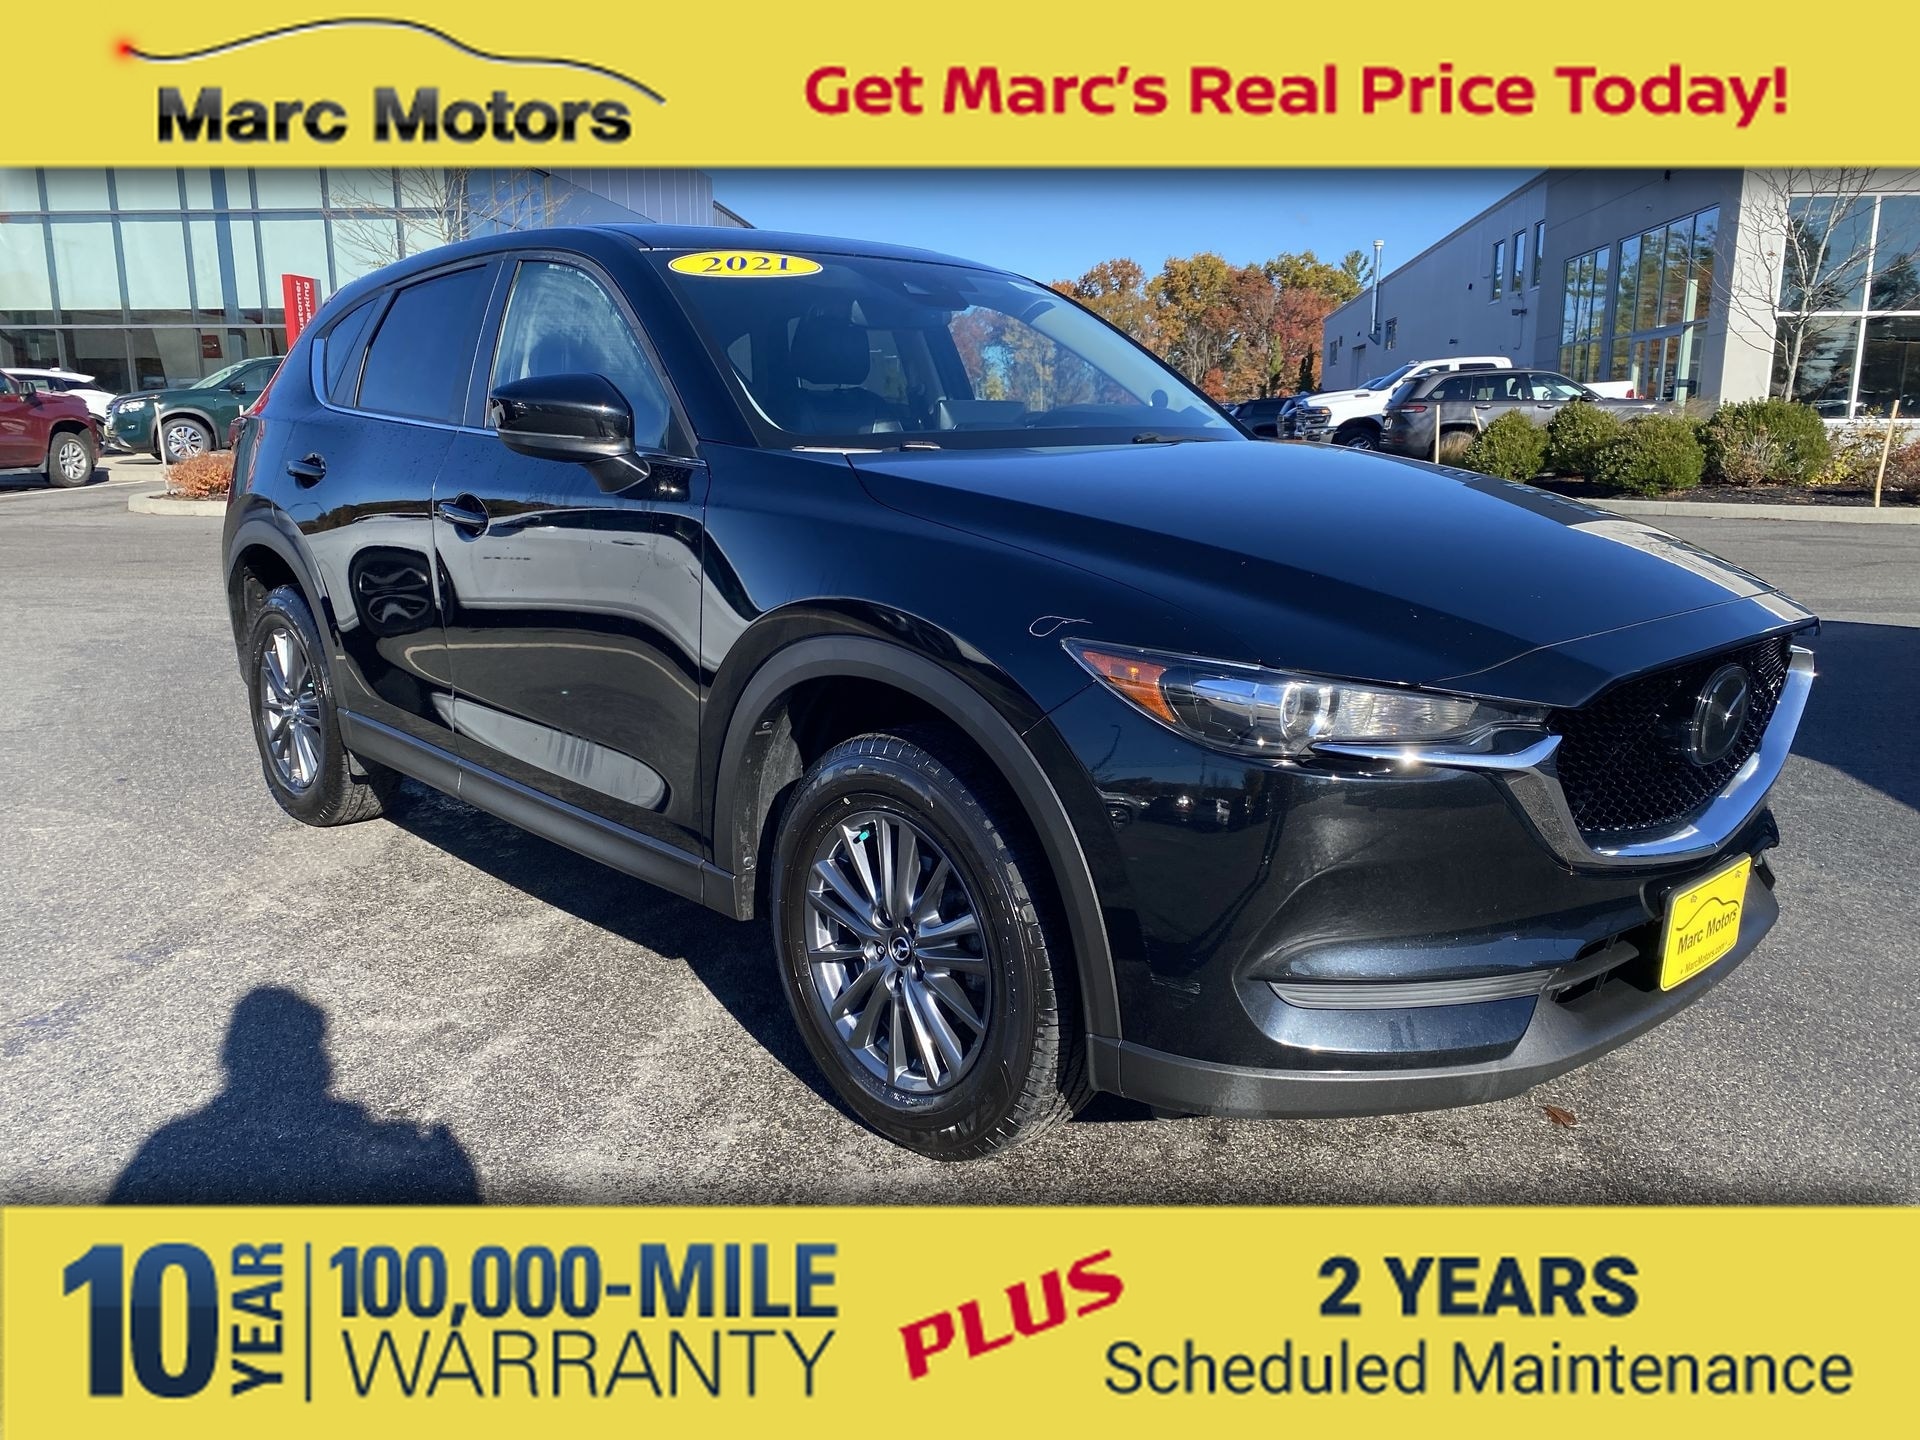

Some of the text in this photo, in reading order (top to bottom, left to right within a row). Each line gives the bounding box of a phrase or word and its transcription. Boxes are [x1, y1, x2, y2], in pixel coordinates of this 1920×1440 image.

[702, 256, 792, 272] 2021
[296, 280, 305, 333] ustomer
[1678, 907, 1738, 955] Marc Motors
